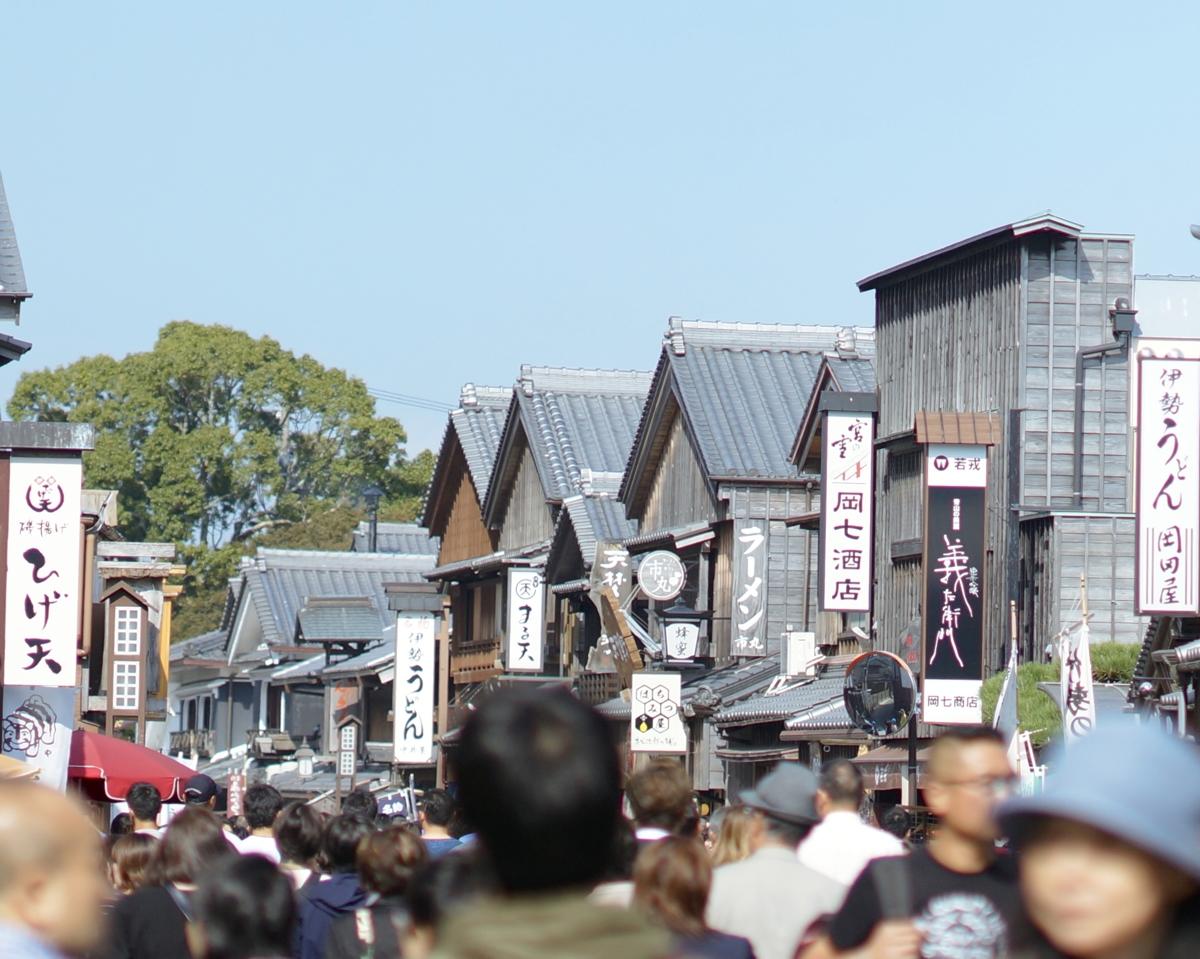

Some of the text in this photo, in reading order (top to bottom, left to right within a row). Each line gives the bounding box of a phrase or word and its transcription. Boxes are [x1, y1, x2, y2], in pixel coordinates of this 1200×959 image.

[954, 457, 981, 471] 若戎
[1153, 369, 1187, 604] 伊勢うどん 岡田屋
[832, 492, 863, 600] 岡七酒店
[646, 559, 671, 593] 市丸
[738, 526, 764, 631] ラーメン
[22, 548, 68, 674] ひげ天
[518, 604, 535, 661] まる天
[735, 635, 764, 650] 市丸
[640, 690, 664, 699] はち
[648, 704, 673, 713] みつ
[927, 695, 978, 708] 岡七商店
